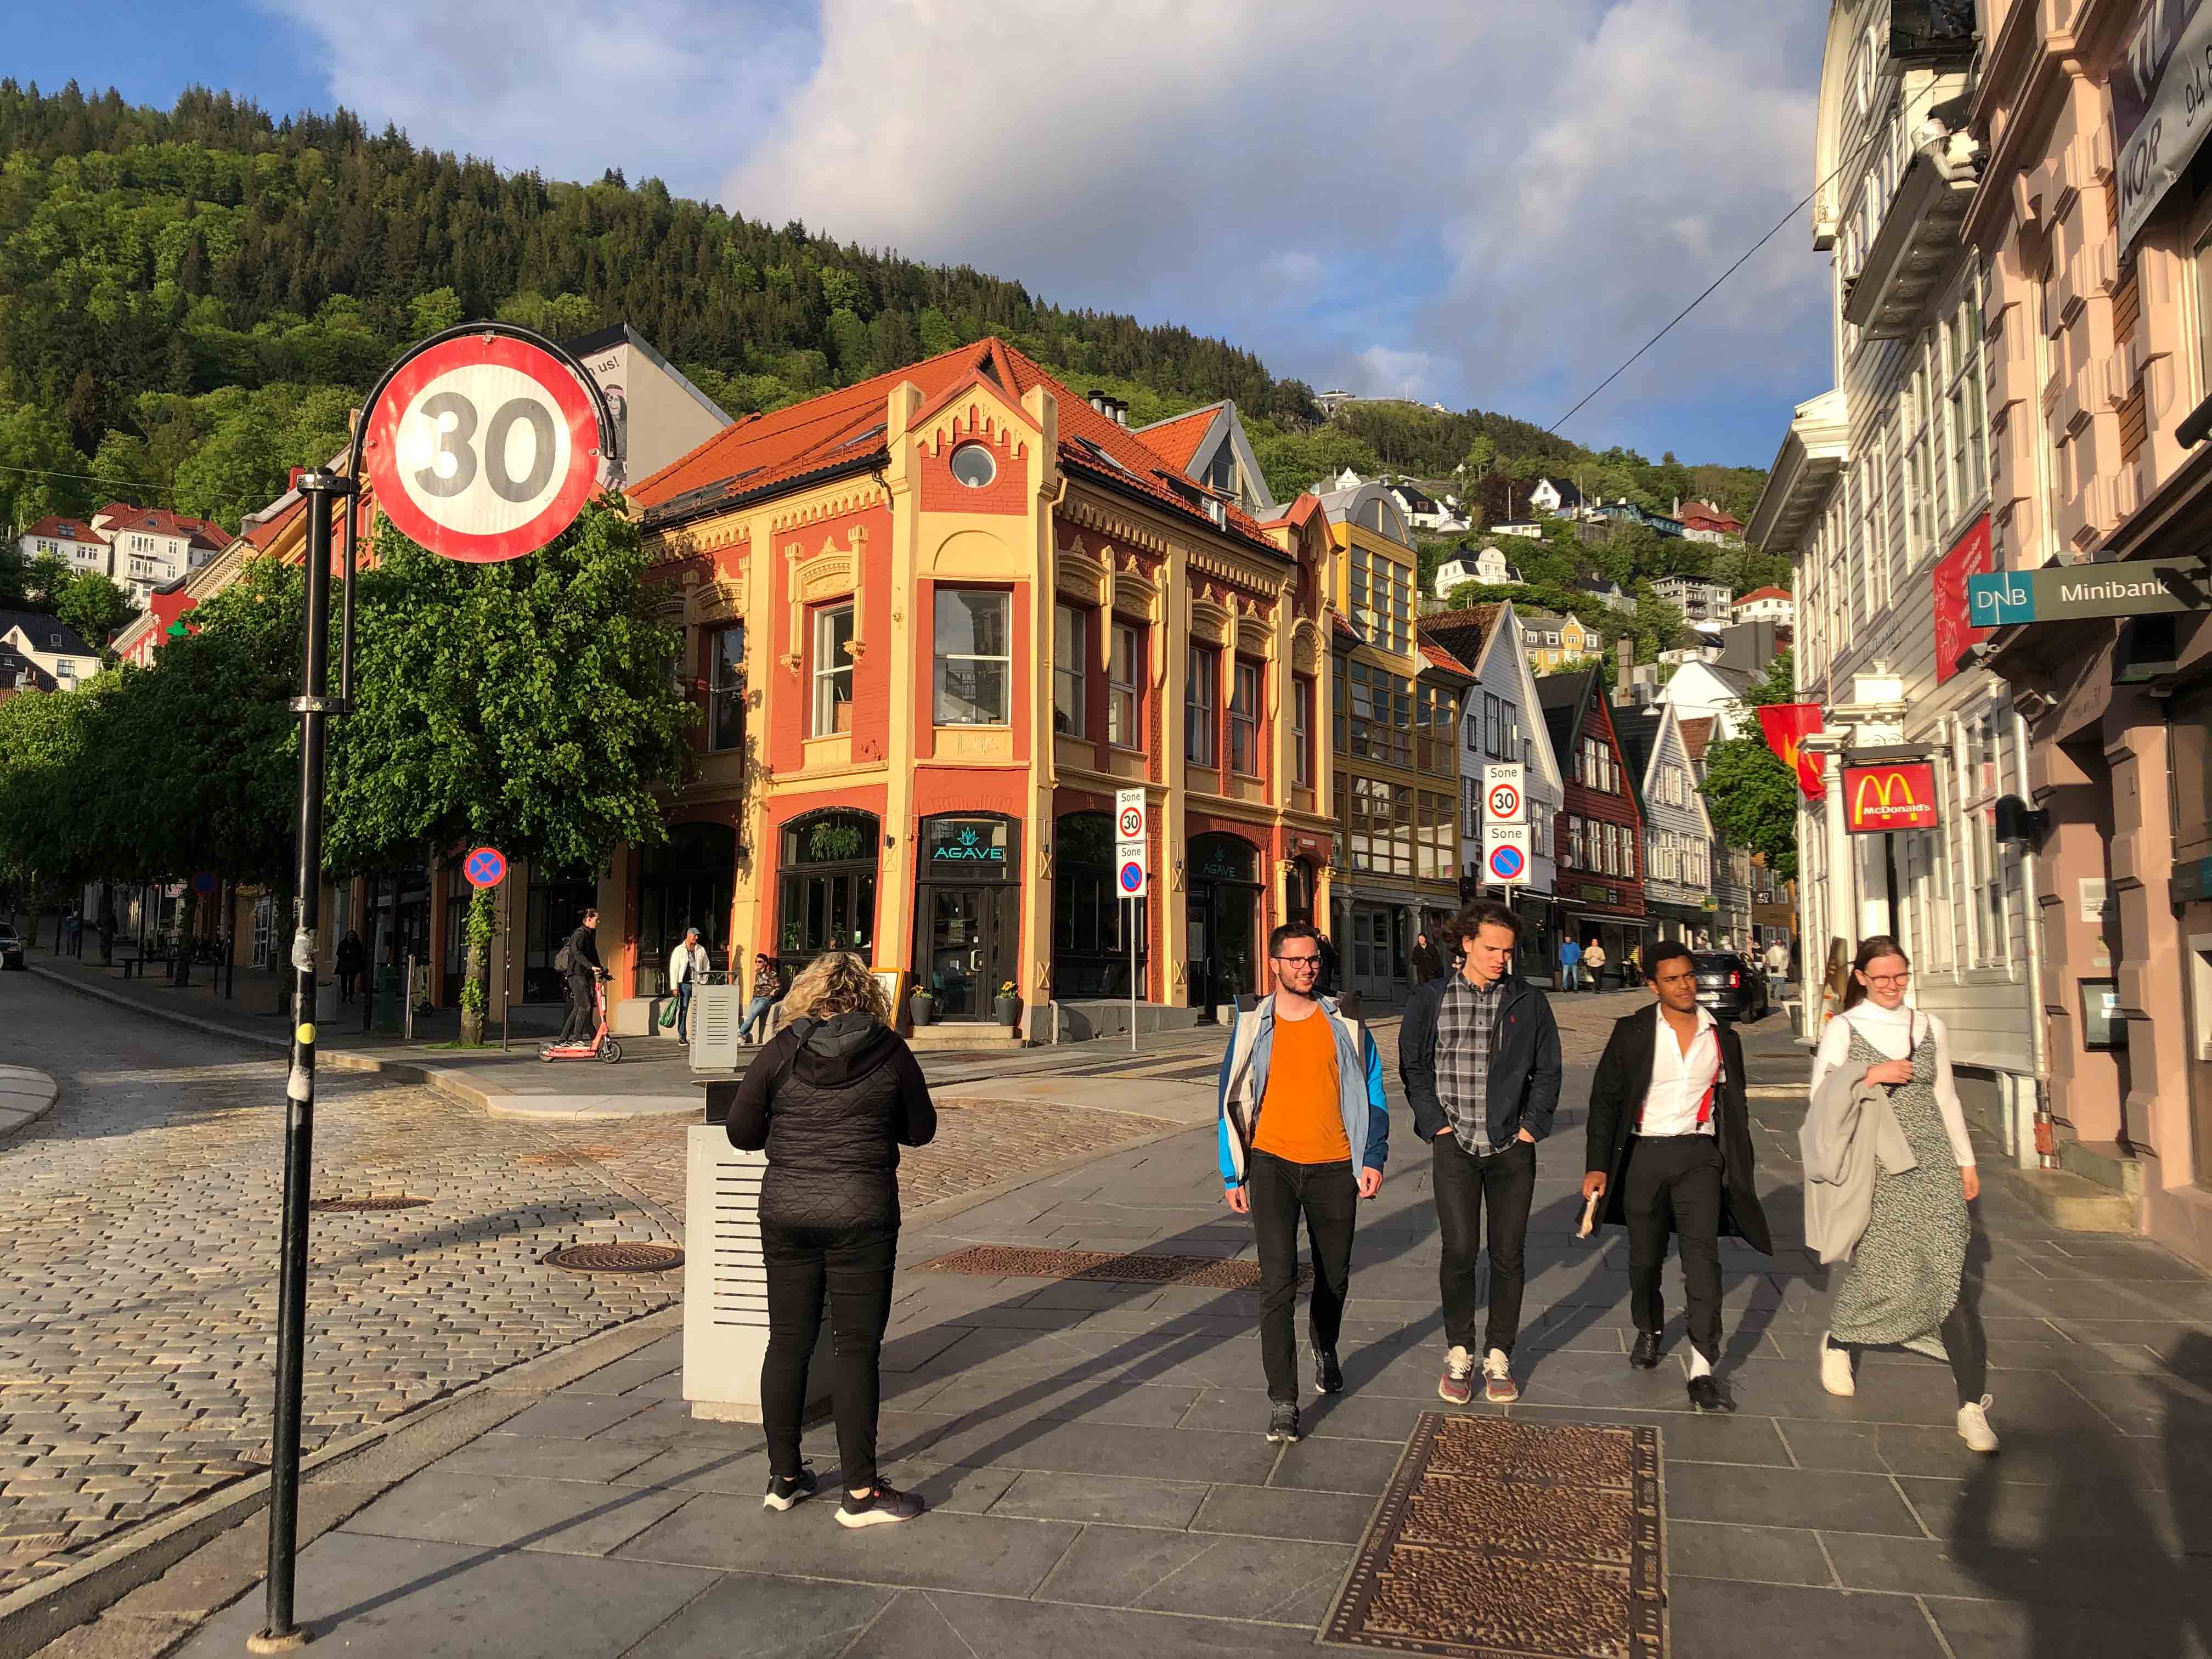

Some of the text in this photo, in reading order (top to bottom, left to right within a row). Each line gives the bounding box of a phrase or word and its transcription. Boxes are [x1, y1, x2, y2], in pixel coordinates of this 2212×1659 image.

[2121, 118, 2162, 219] NOR
[597, 355, 620, 373] us!
[414, 391, 556, 503] 30
[2061, 578, 2171, 602] Minibank
[1491, 768, 1517, 778] Sone
[1121, 793, 1141, 802] Sone
[1494, 792, 1514, 809] 30
[1863, 803, 1932, 815] McDonald's
[1124, 814, 1138, 830] 30
[1492, 828, 1522, 838] Sone
[934, 847, 1002, 860] AGAVE
[1121, 847, 1141, 857] Sone
[1203, 862, 1235, 878] AGAVE
